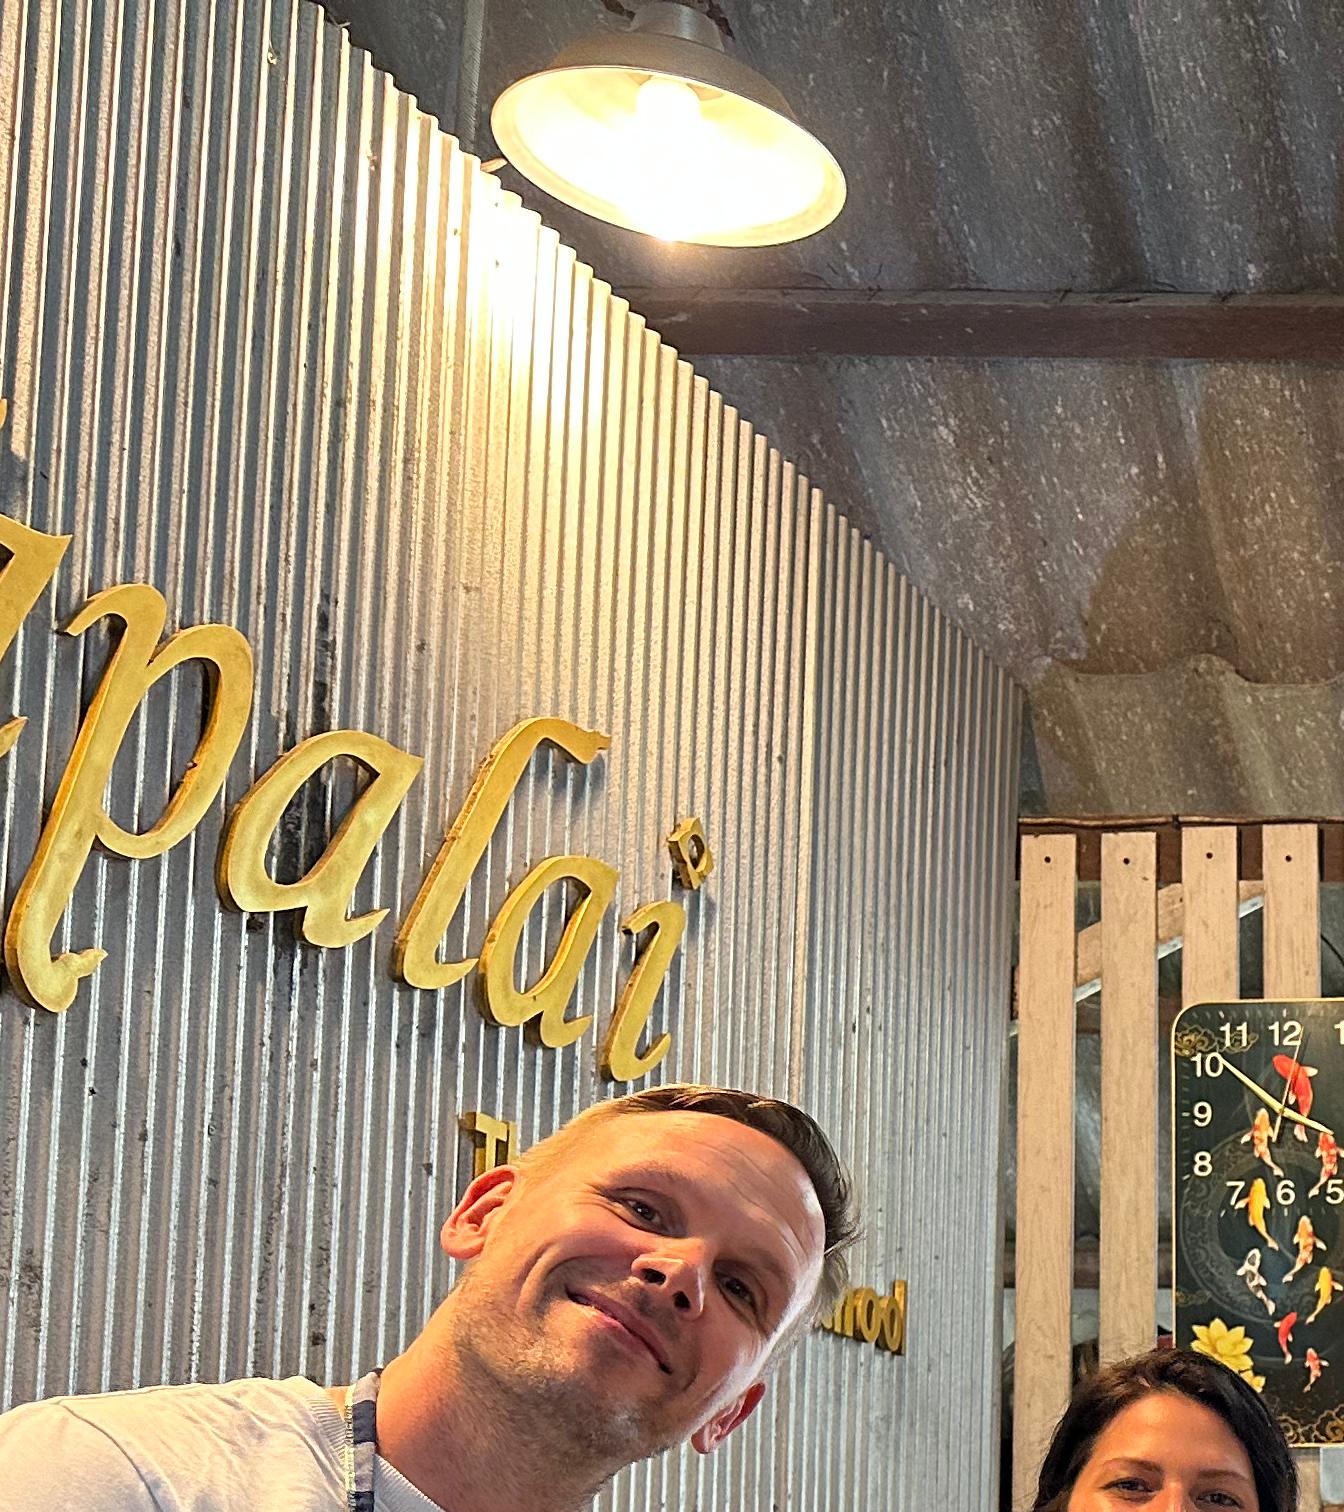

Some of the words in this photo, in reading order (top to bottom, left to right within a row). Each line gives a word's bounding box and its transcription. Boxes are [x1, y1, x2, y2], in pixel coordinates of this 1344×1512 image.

[1219, 1021, 1248, 1047] 11
[1268, 1020, 1302, 1046] 12
[1190, 1052, 1224, 1078] 10
[1193, 1101, 1213, 1127] 9
[1193, 1151, 1213, 1177] 8
[1226, 1181, 1246, 1206] 7
[1276, 1179, 1296, 1205] 6
[1325, 1179, 1344, 1204] 5
